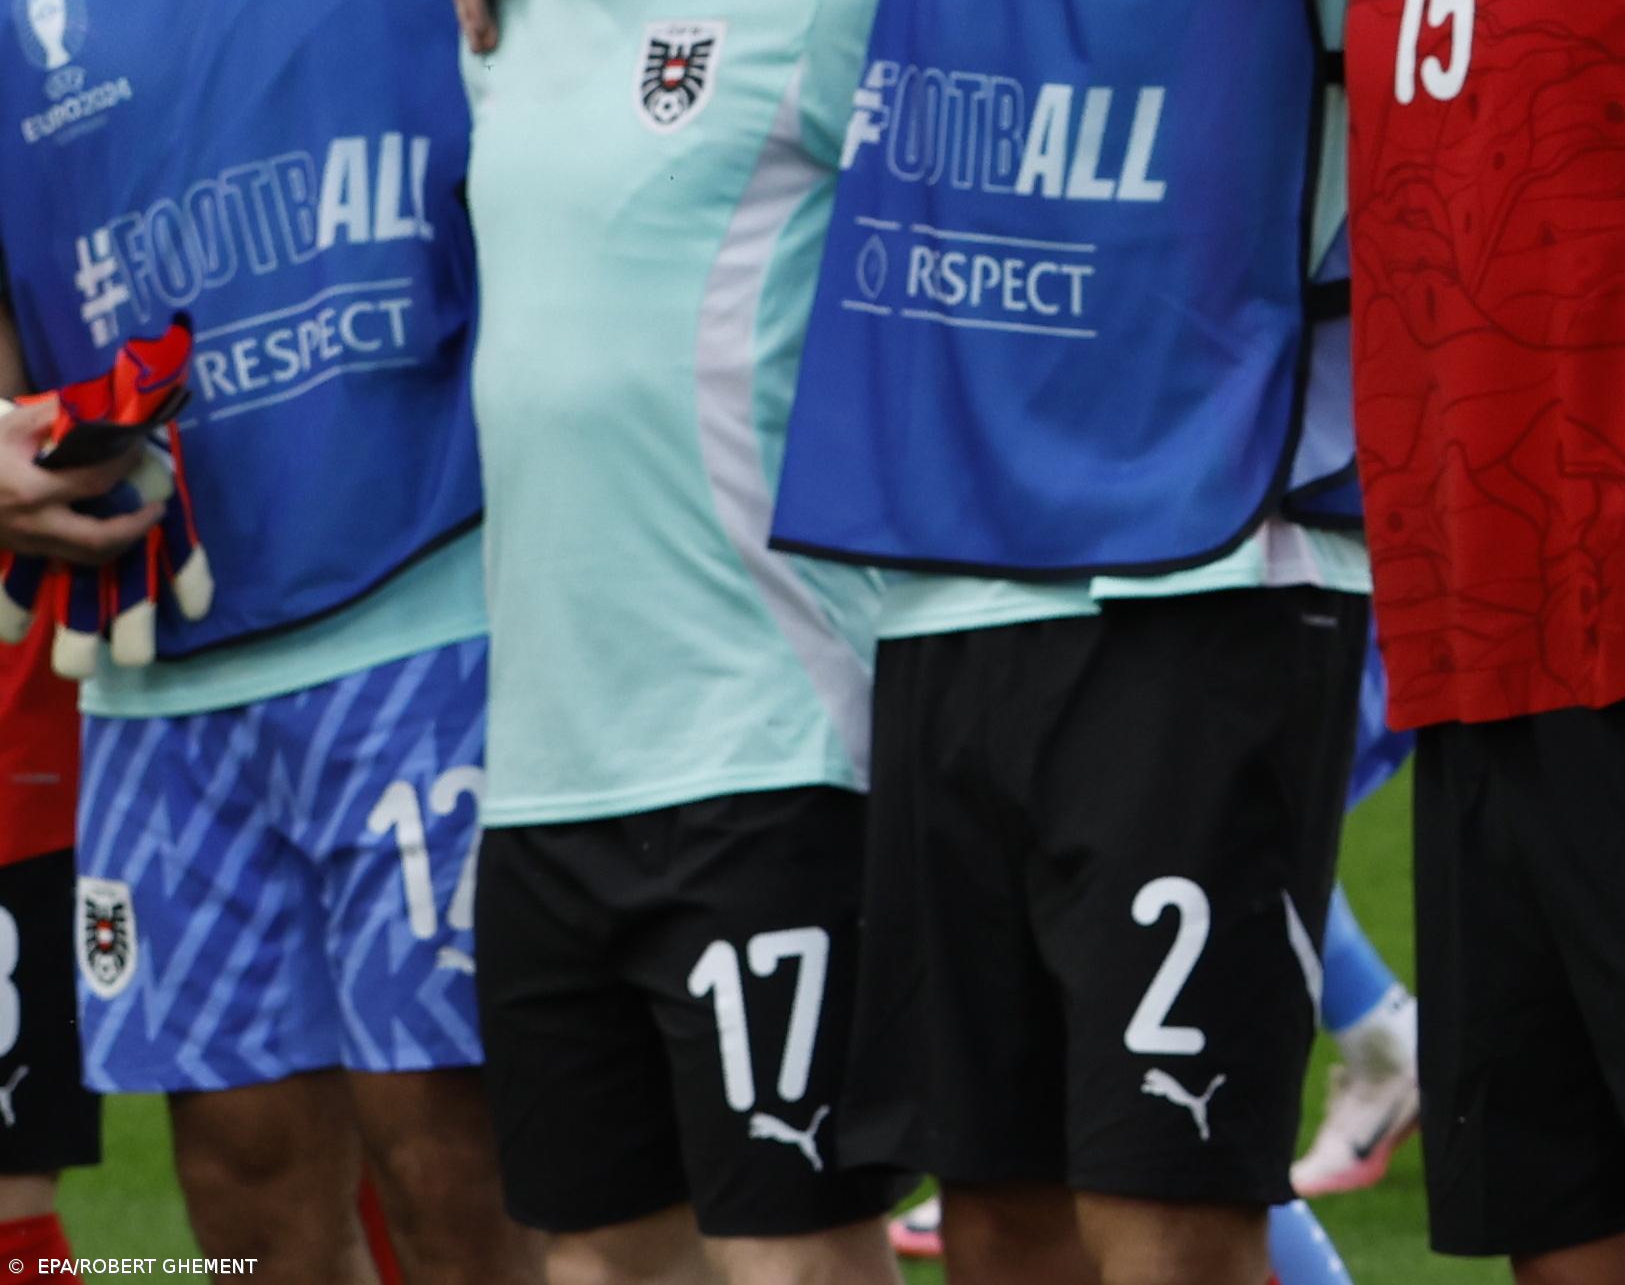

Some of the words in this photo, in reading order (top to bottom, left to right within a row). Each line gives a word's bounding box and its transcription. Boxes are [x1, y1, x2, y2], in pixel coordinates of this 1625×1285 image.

[195, 298, 414, 401] RESPECT
[907, 246, 1095, 316] RSPECT
[687, 927, 829, 1112] 17
[1124, 876, 1210, 1054] 2
